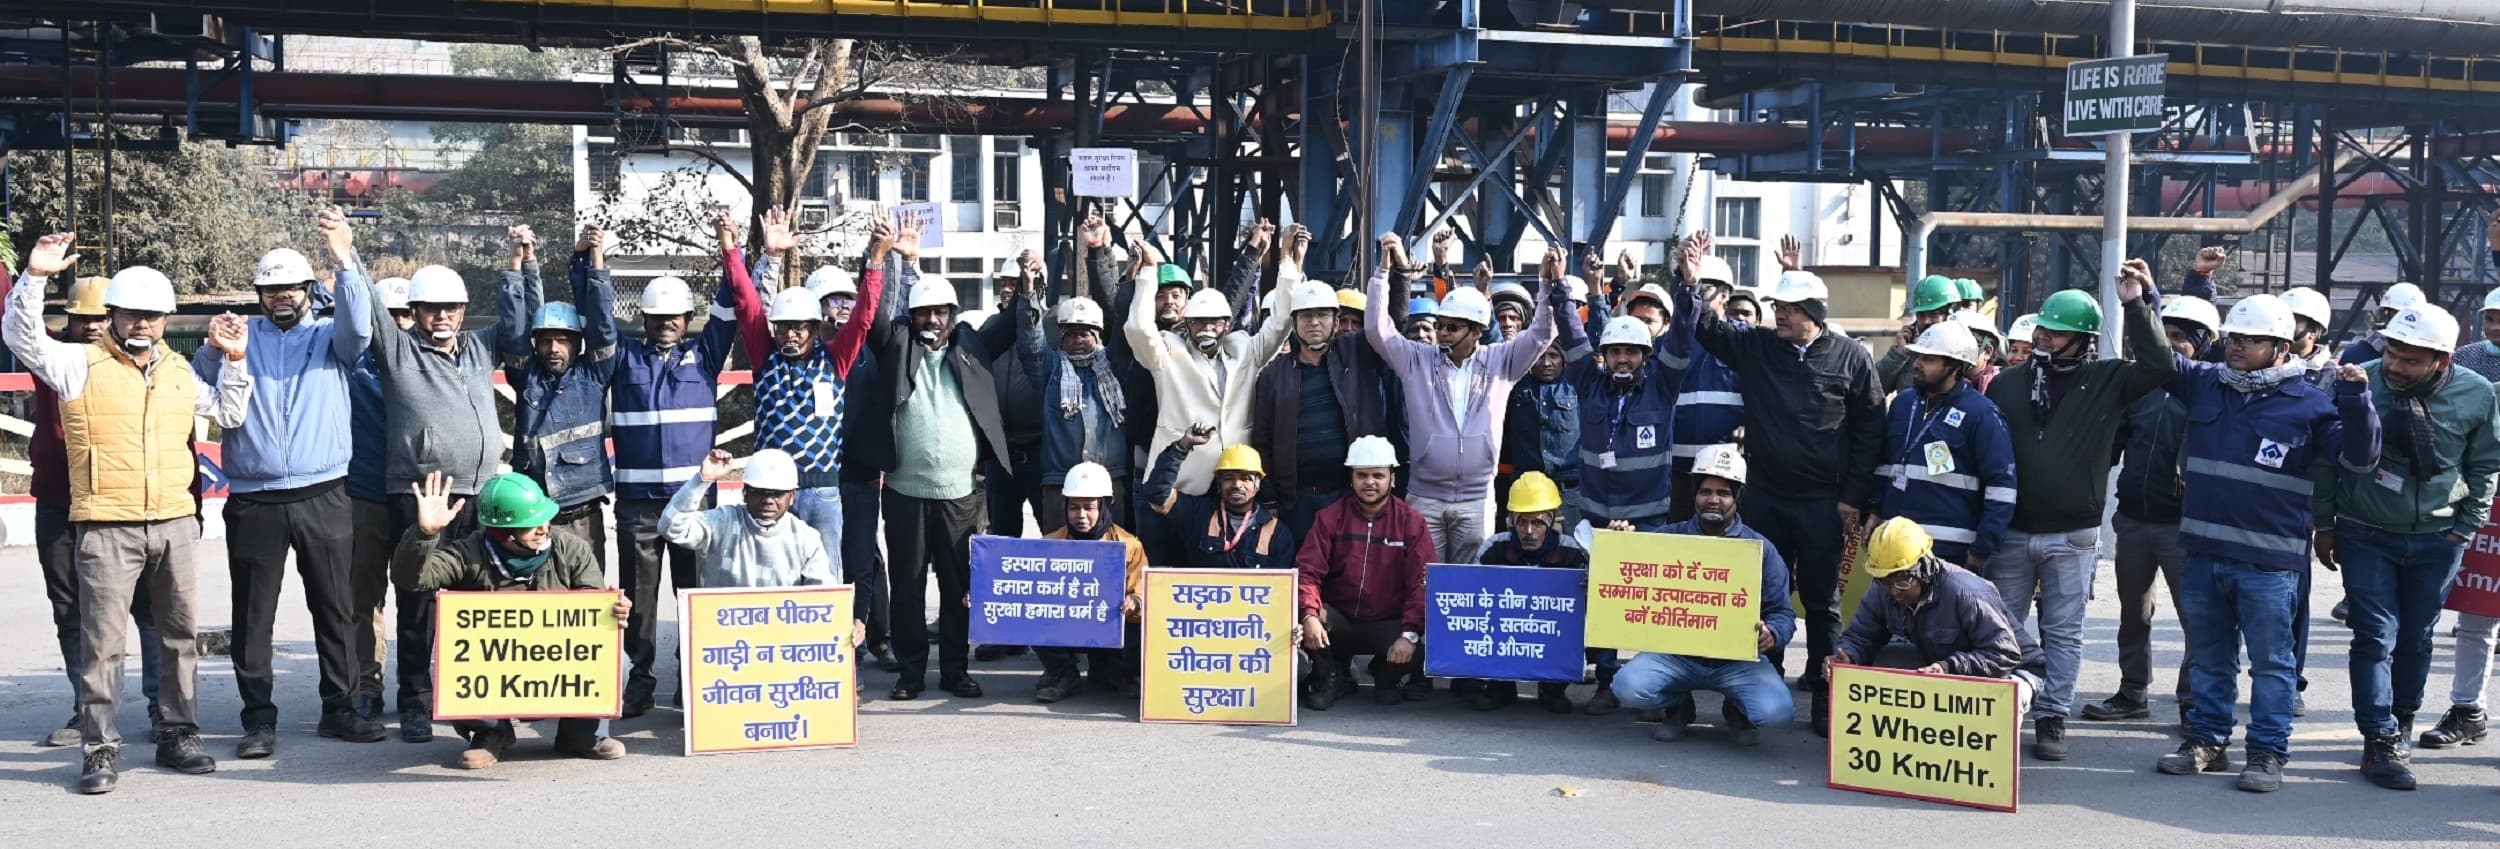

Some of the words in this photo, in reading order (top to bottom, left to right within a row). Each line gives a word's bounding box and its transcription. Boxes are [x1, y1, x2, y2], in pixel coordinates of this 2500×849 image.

[2071, 66, 2102, 91] LIFE
[2104, 65, 2120, 89] IS
[2123, 62, 2166, 87] RARE
[2067, 98, 2097, 121] LIVE
[2098, 96, 2134, 120] WITH
[2134, 94, 2165, 118] CARE
[2464, 533, 2500, 555] EH
[1001, 556, 1048, 574] इस्पात
[1050, 557, 1094, 574] बनाना
[1619, 560, 1659, 584] सुरक्षा
[1662, 559, 1684, 580] को
[1686, 560, 1702, 581] दें
[1702, 566, 1730, 583] जब
[992, 579, 1034, 596] हमारा
[1036, 576, 1067, 597] कर्म
[1067, 576, 1081, 599] है
[1082, 577, 1101, 597] तो
[1171, 584, 1234, 611] सड़क
[1238, 585, 1272, 605] पर
[1598, 583, 1650, 601] सम्मान
[1651, 586, 1728, 608] उत्पादकता
[1731, 587, 1749, 608] के
[716, 606, 771, 627] शराब
[775, 599, 835, 625] पीकर
[983, 601, 1023, 625] सुरक्षा
[1024, 603, 1066, 620] हमारा
[1068, 599, 1094, 620] धर्म
[1096, 600, 1109, 623] है
[1435, 591, 1476, 616] सुरक्षा
[1477, 587, 1495, 609] के
[1498, 587, 1529, 610] तीन
[1530, 594, 1576, 613] आधार
[456, 609, 534, 629] SPEED
[542, 608, 603, 628] LIMIT
[1166, 613, 1272, 642] सावधानी,
[1446, 610, 1495, 634] सफाई,
[1499, 613, 1562, 638] सतर्कता,
[1624, 604, 1651, 625] बनें
[1651, 606, 1719, 631] कीर्तिमान
[454, 638, 470, 663] 2
[479, 638, 604, 663] Wheeler
[702, 639, 751, 672] गाड़ी
[755, 645, 775, 664] न
[780, 635, 845, 664] चलाएं,
[1167, 645, 1233, 673] जीवन
[1238, 647, 1272, 674] की
[1463, 634, 1494, 657] सही
[1496, 635, 1546, 659] औजार
[455, 674, 490, 699] 30
[499, 673, 601, 699] Km/Hr.
[702, 678, 763, 705] जीवन
[767, 675, 841, 709] सुरक्षित
[1848, 683, 1926, 710] SPEED
[1933, 692, 1997, 717] LIMIT
[1845, 711, 1863, 736] 2
[1871, 714, 1999, 752] Wheeler
[1847, 746, 1882, 774] 30
[1892, 752, 1996, 789] Km/Hr.
